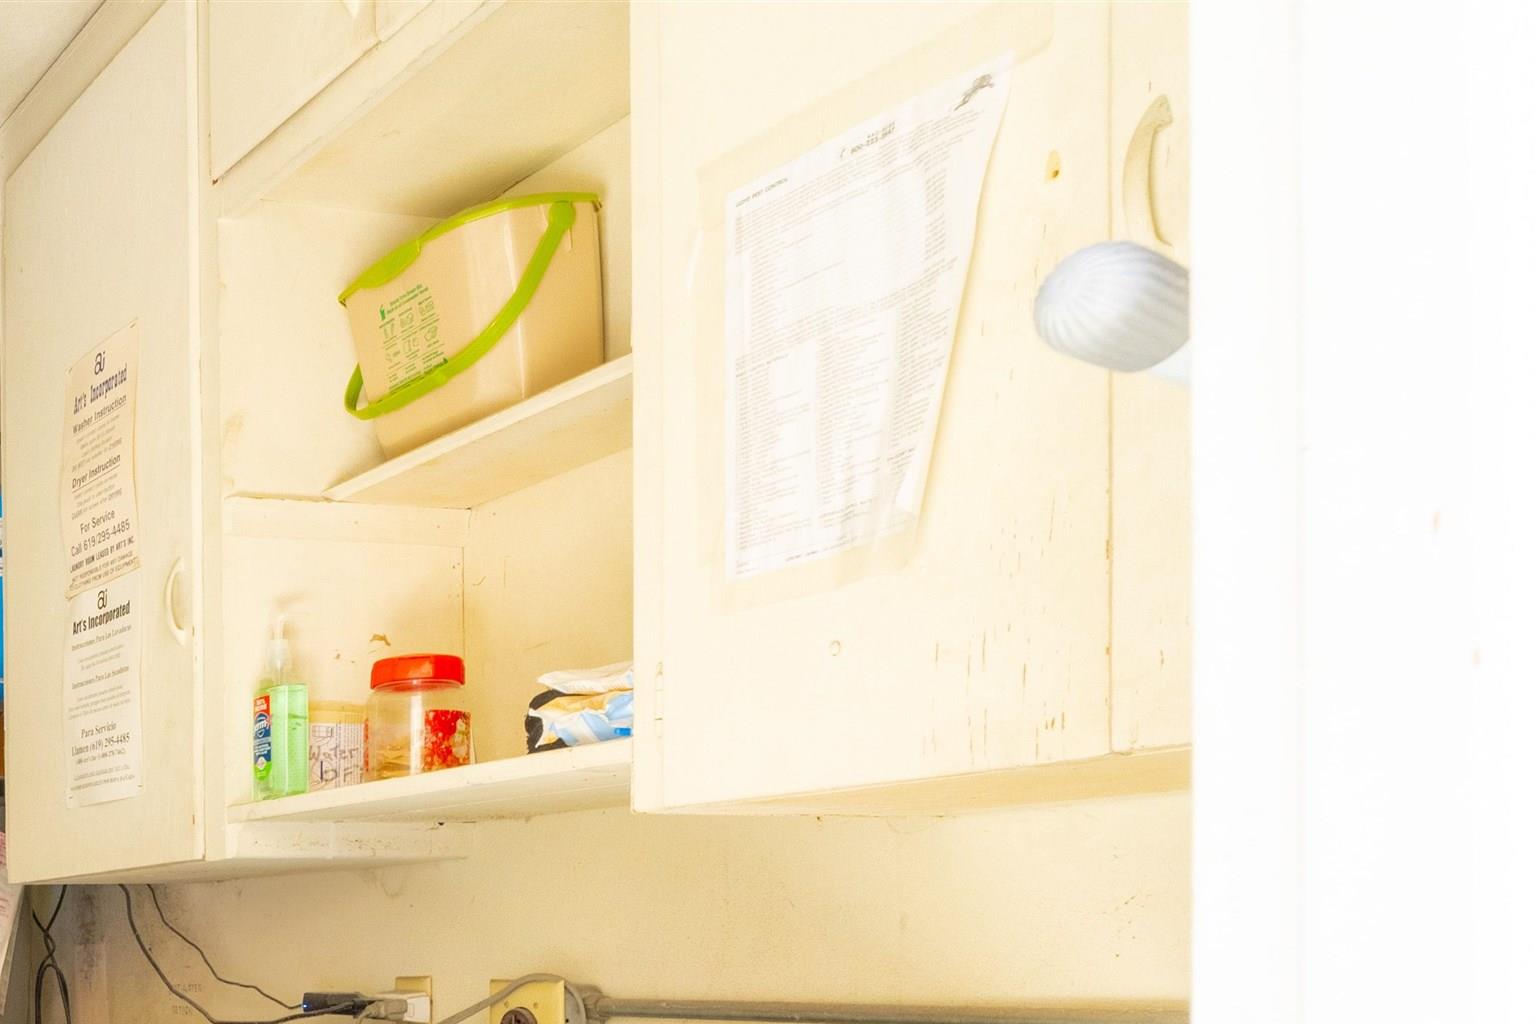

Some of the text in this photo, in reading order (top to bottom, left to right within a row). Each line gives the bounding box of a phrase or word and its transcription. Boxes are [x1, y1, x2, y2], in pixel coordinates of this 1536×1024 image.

[90, 362, 128, 403] Incorporated
[72, 394, 127, 434] Washer Instruction
[71, 454, 121, 489] Dryer Instruction
[80, 509, 116, 534] For Service
[71, 541, 82, 557] Call
[72, 600, 131, 636] Art's Incorporated
[309, 745, 359, 761] Water
